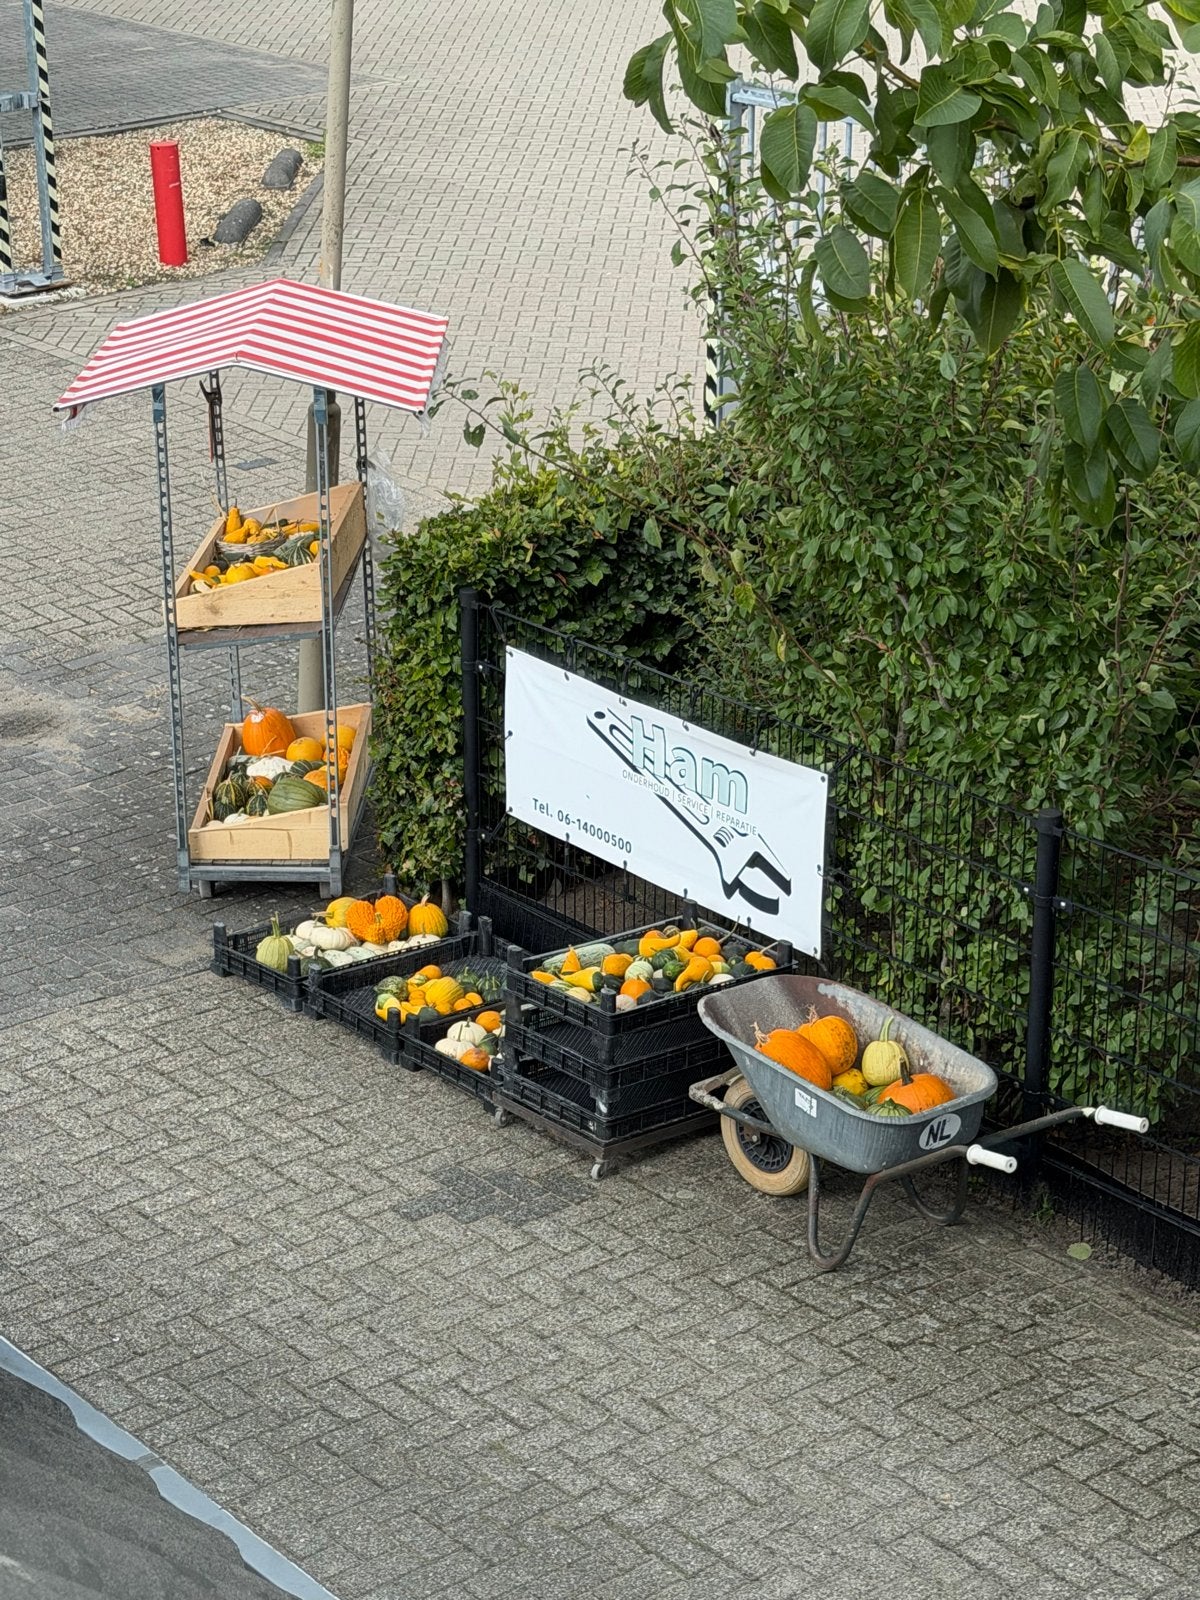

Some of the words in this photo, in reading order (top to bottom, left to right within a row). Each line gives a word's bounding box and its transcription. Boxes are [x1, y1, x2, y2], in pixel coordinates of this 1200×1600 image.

[630, 715, 749, 815] Ham
[532, 797, 553, 818] Tel.
[557, 809, 632, 854] 06-14000500
[622, 769, 670, 798] ONDERHOUD
[677, 793, 708, 815] SERVICE
[716, 810, 757, 836] REPARATIE
[925, 1119, 951, 1147] NL
